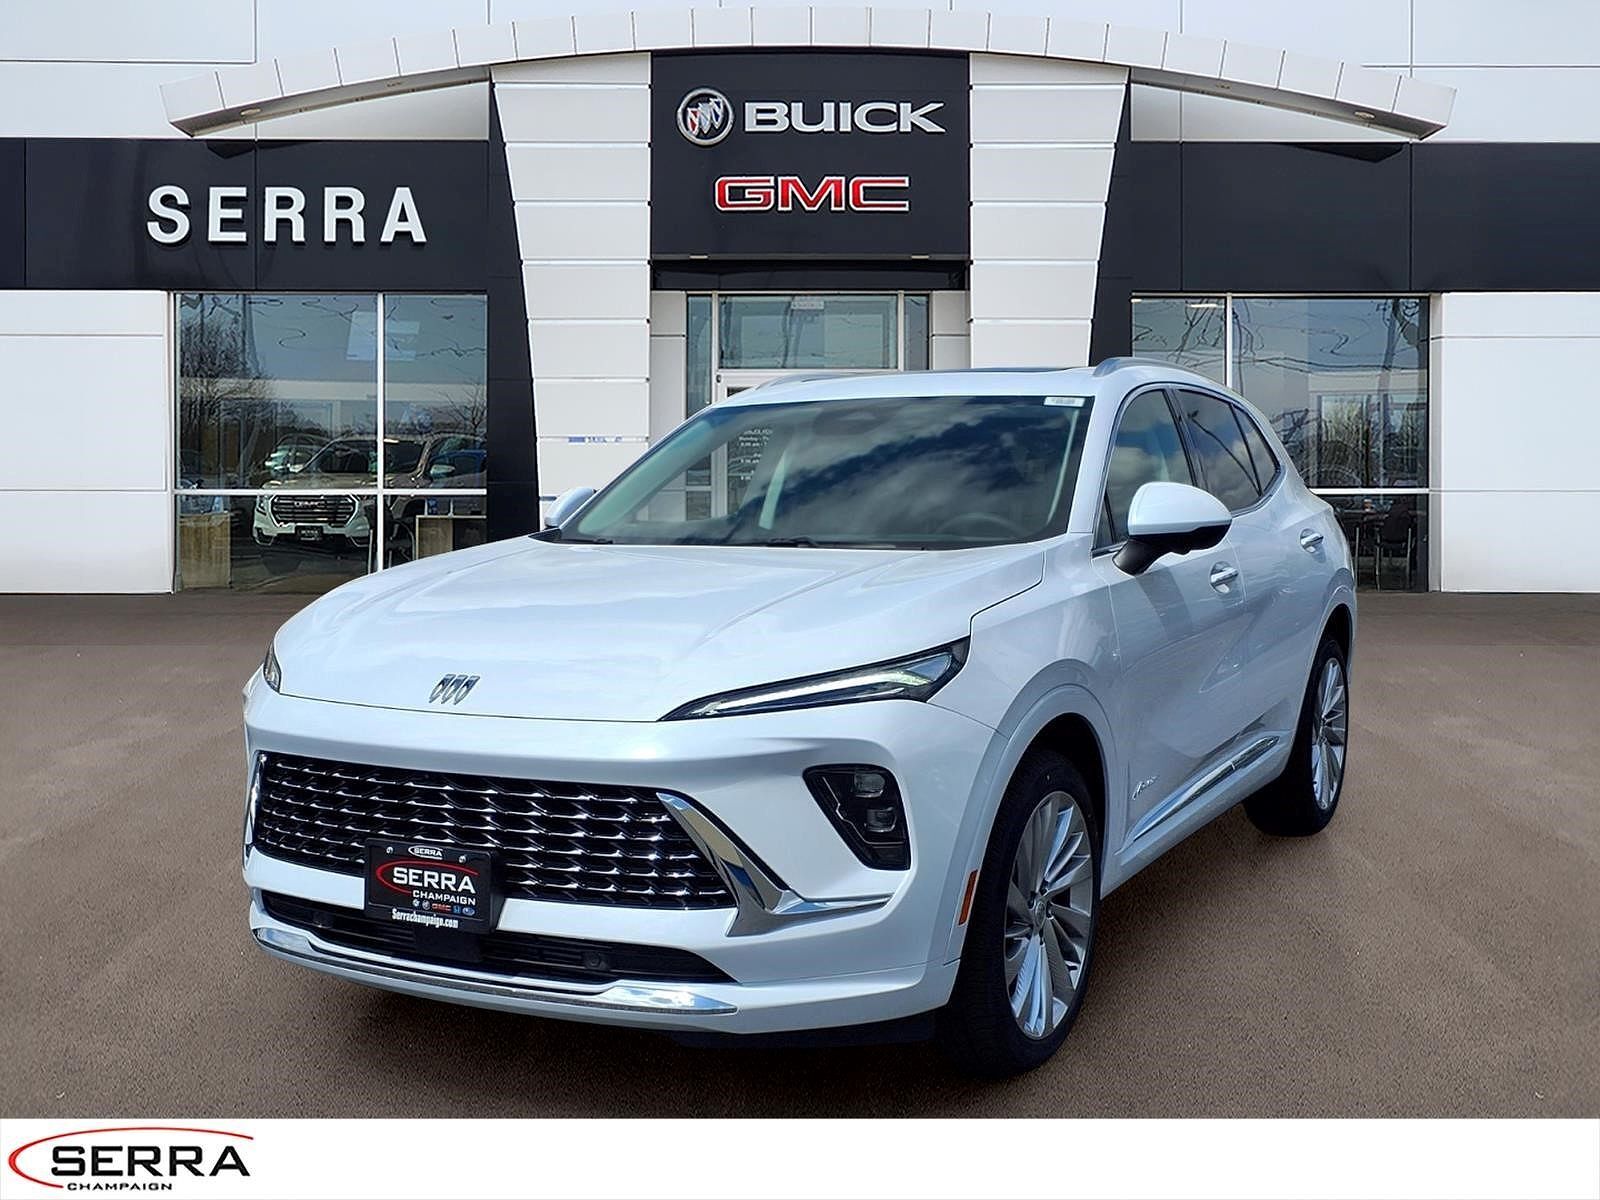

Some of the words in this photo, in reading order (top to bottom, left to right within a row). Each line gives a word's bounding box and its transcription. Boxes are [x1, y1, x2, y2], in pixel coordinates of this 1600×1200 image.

[744, 101, 946, 133] BUICK
[714, 175, 910, 212] GMC
[146, 184, 428, 244] SERRA
[413, 847, 443, 857] SERRA
[392, 867, 476, 894] SERRA
[412, 890, 476, 906] CHAMPAIGN
